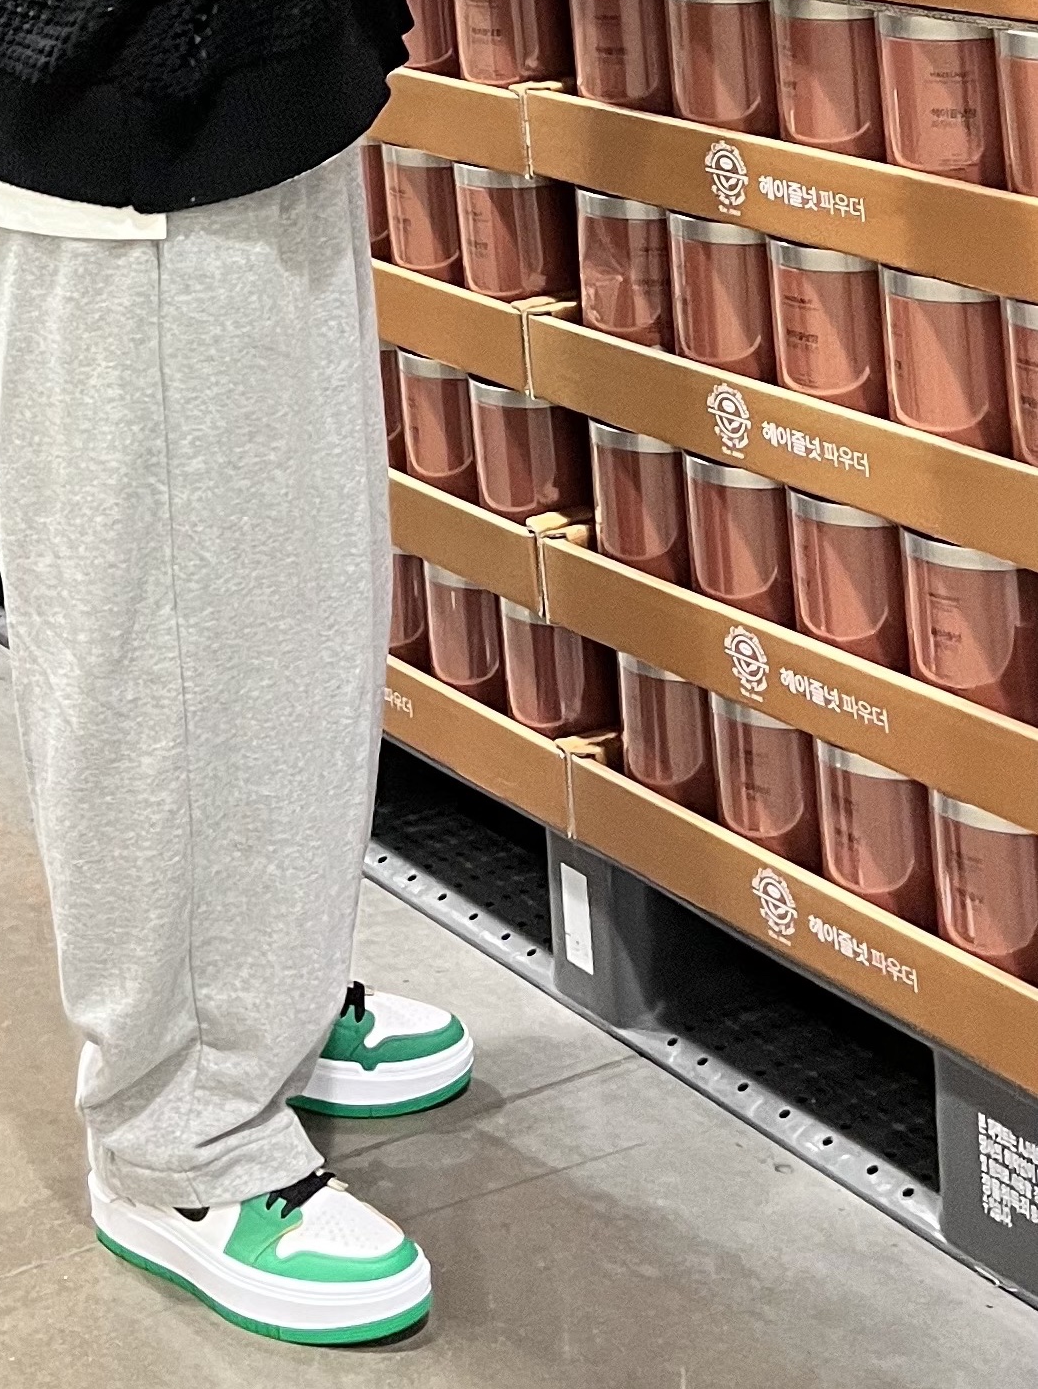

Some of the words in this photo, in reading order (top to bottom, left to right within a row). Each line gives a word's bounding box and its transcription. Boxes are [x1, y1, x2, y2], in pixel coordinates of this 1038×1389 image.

[758, 175, 818, 211] 헤이즐넛
[819, 190, 866, 222] 파우더
[762, 420, 822, 462] 헤이즐넛
[822, 441, 870, 478] 파우더
[779, 667, 841, 713] 헤이즐넛
[841, 693, 890, 734] 파우더
[808, 914, 870, 967] 헤이즐넛
[871, 948, 919, 994] 파우더
